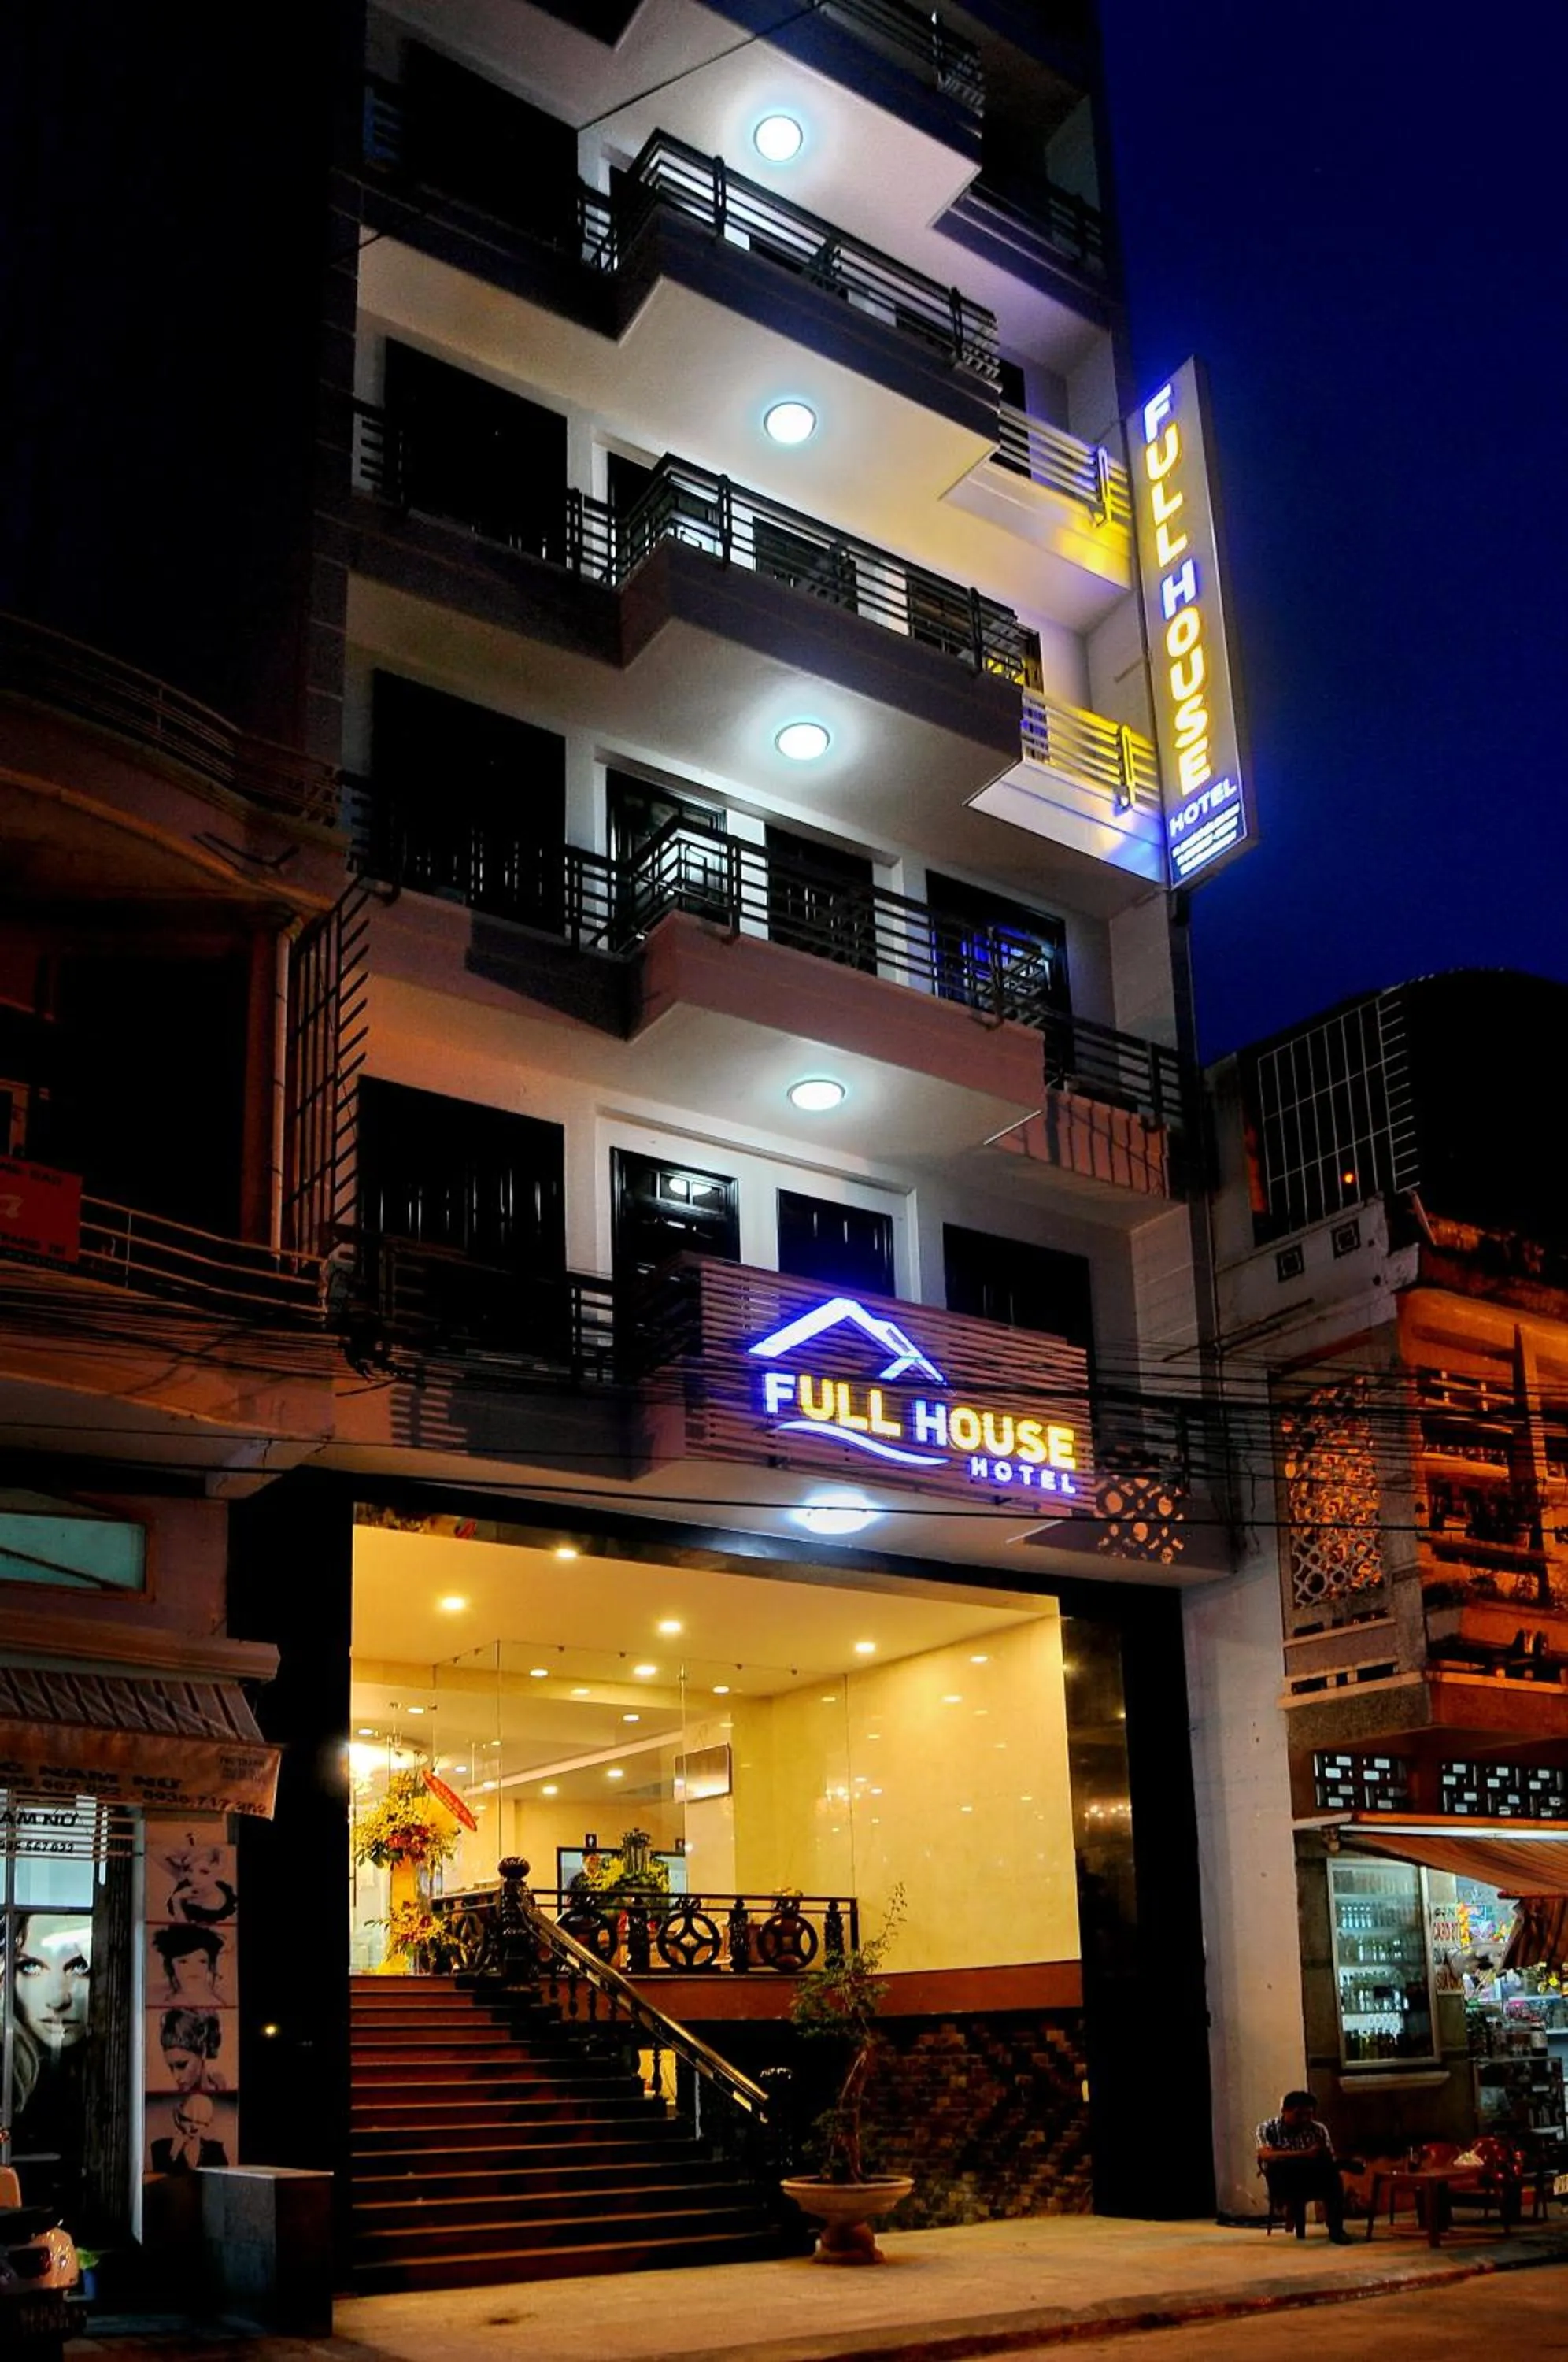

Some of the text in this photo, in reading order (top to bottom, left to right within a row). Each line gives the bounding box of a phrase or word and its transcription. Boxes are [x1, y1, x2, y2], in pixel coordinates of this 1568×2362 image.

[1144, 383, 1187, 568] FULL
[1162, 558, 1211, 796] HOUSE
[1170, 777, 1237, 839] HOTEL
[764, 1373, 1077, 1470] FULL HOUSE
[970, 1457, 1077, 1494] HOTEL
